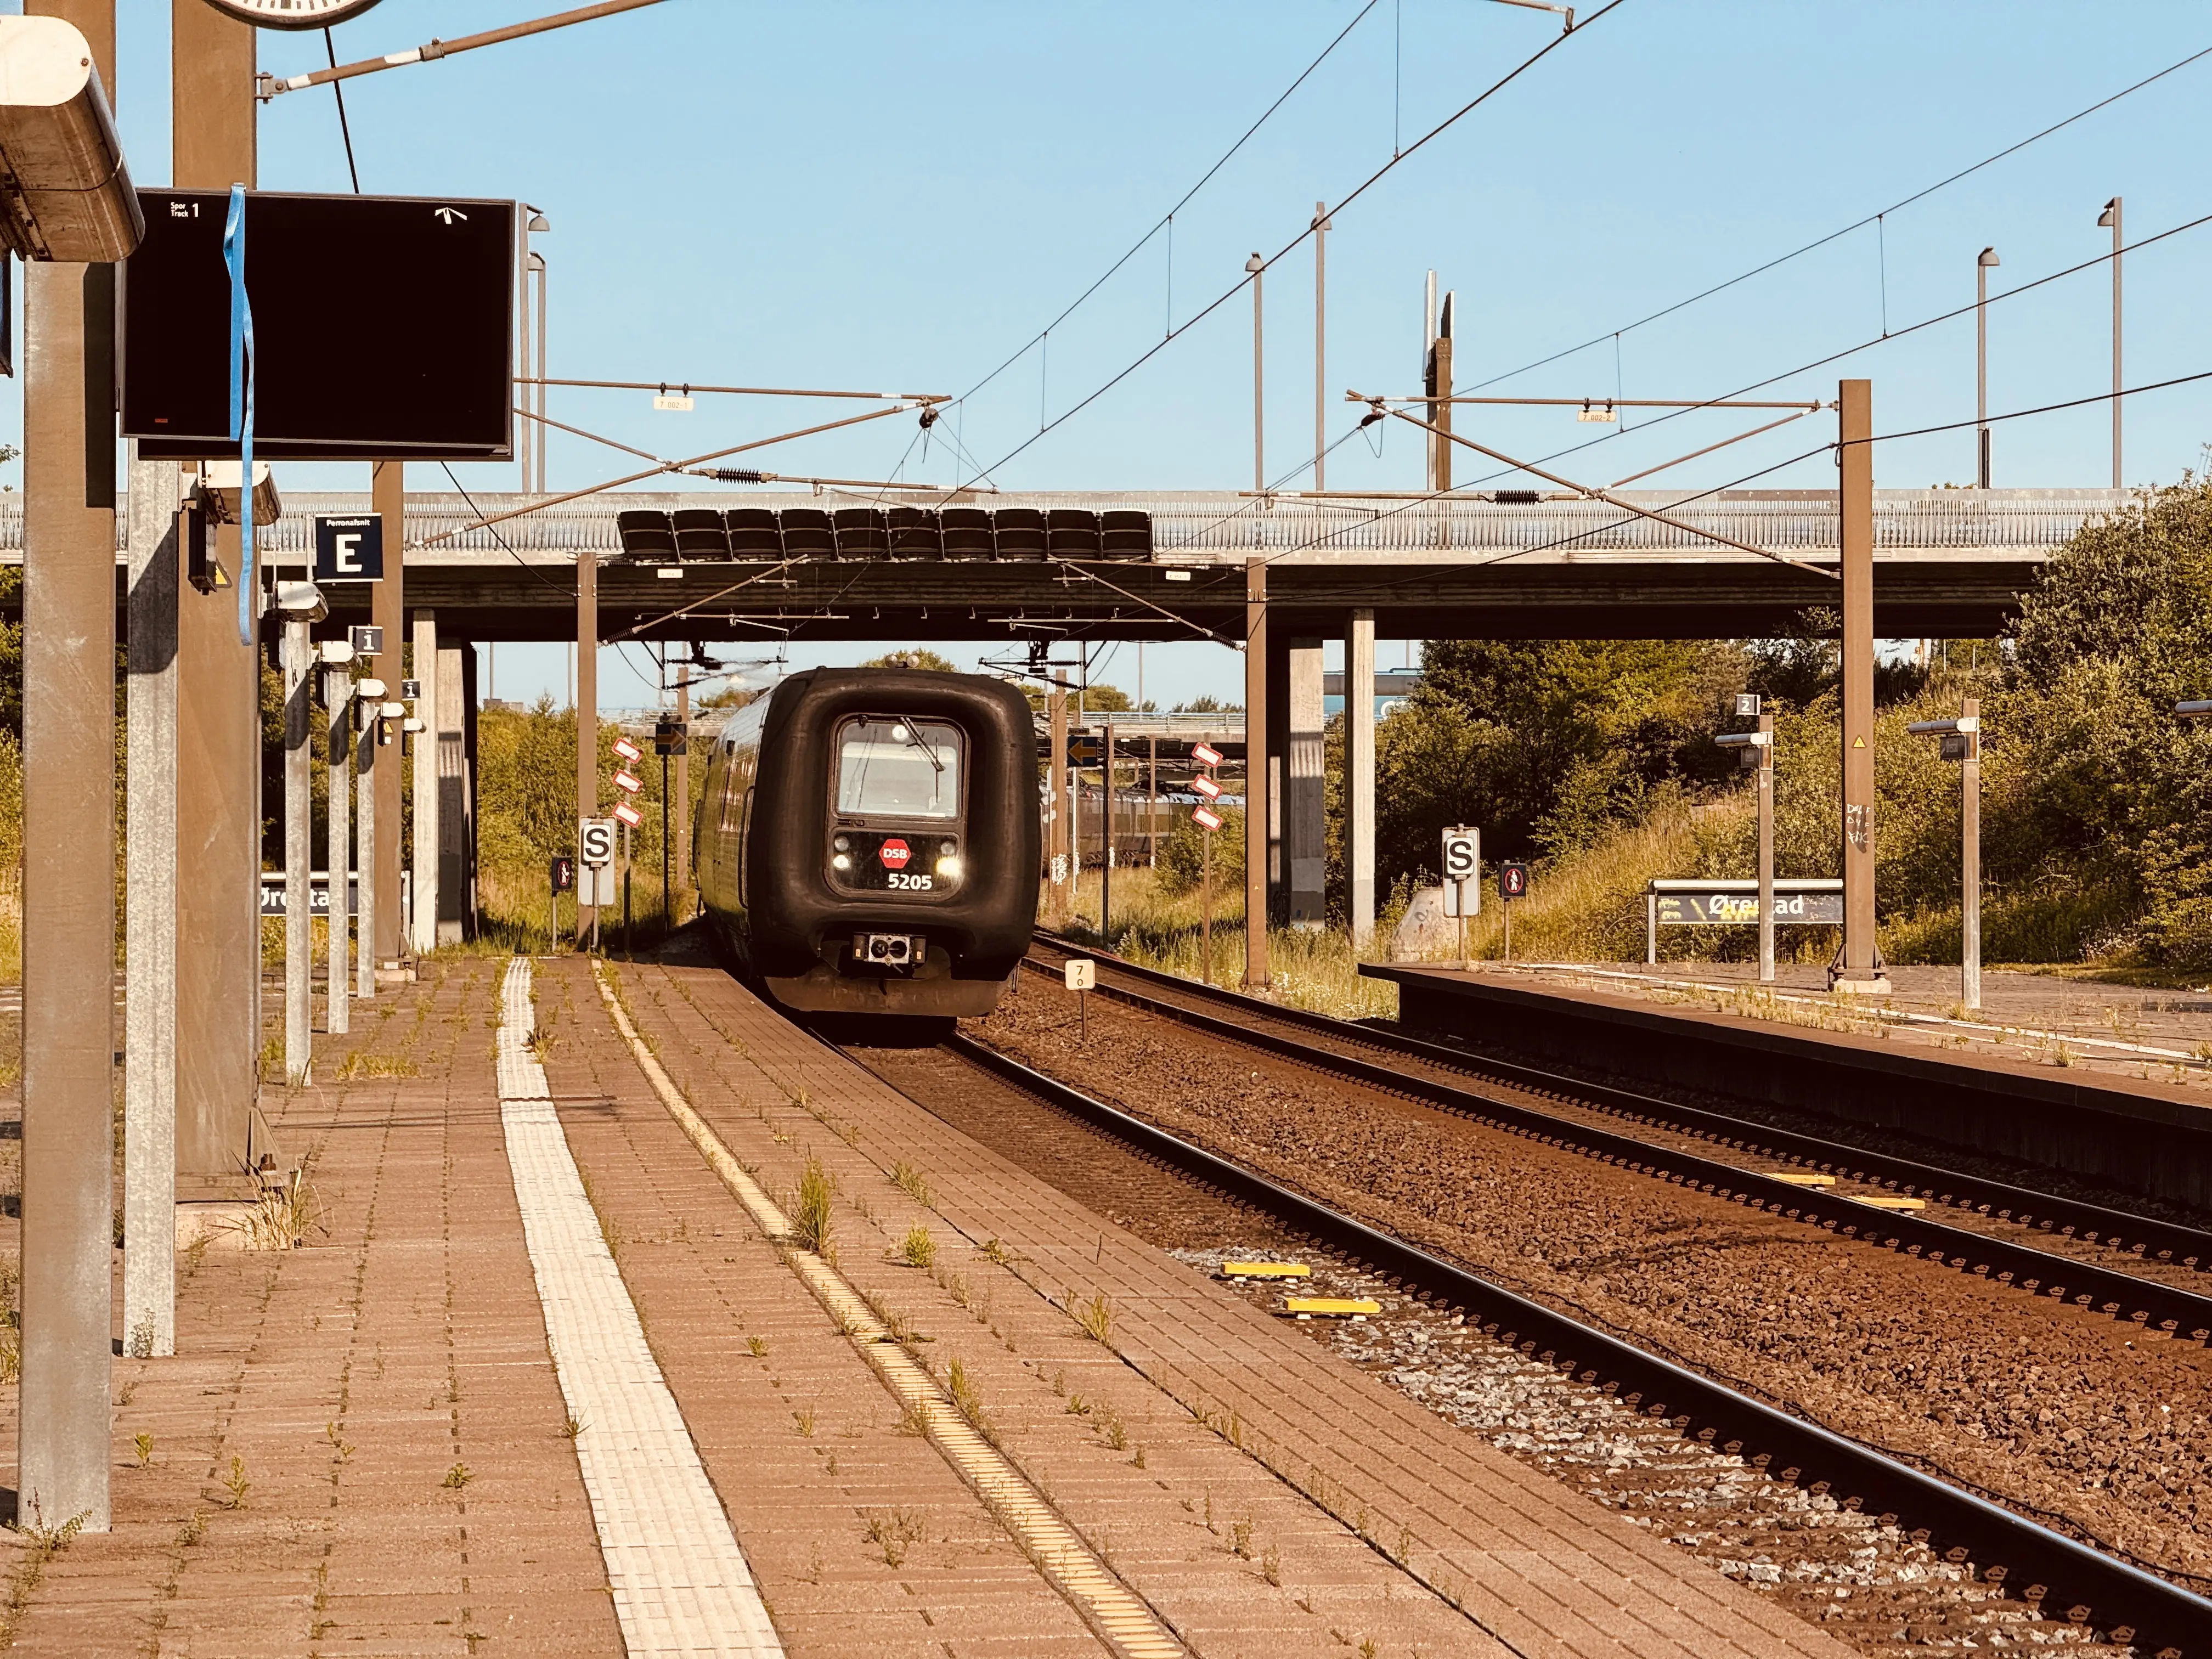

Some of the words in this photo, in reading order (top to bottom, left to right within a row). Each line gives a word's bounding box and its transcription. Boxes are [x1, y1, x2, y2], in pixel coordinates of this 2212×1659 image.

[171, 201, 186, 211] Spor
[171, 209, 189, 217] Track
[191, 203, 199, 217] 1
[336, 534, 362, 572] E
[364, 634, 374, 650] 1
[1741, 700, 1750, 712] 2
[585, 828, 610, 857] S
[883, 848, 907, 859] DSB
[1449, 841, 1472, 871] S
[888, 873, 932, 890] 5205
[1709, 895, 1804, 915] Øread
[1076, 966, 1084, 975] 7
